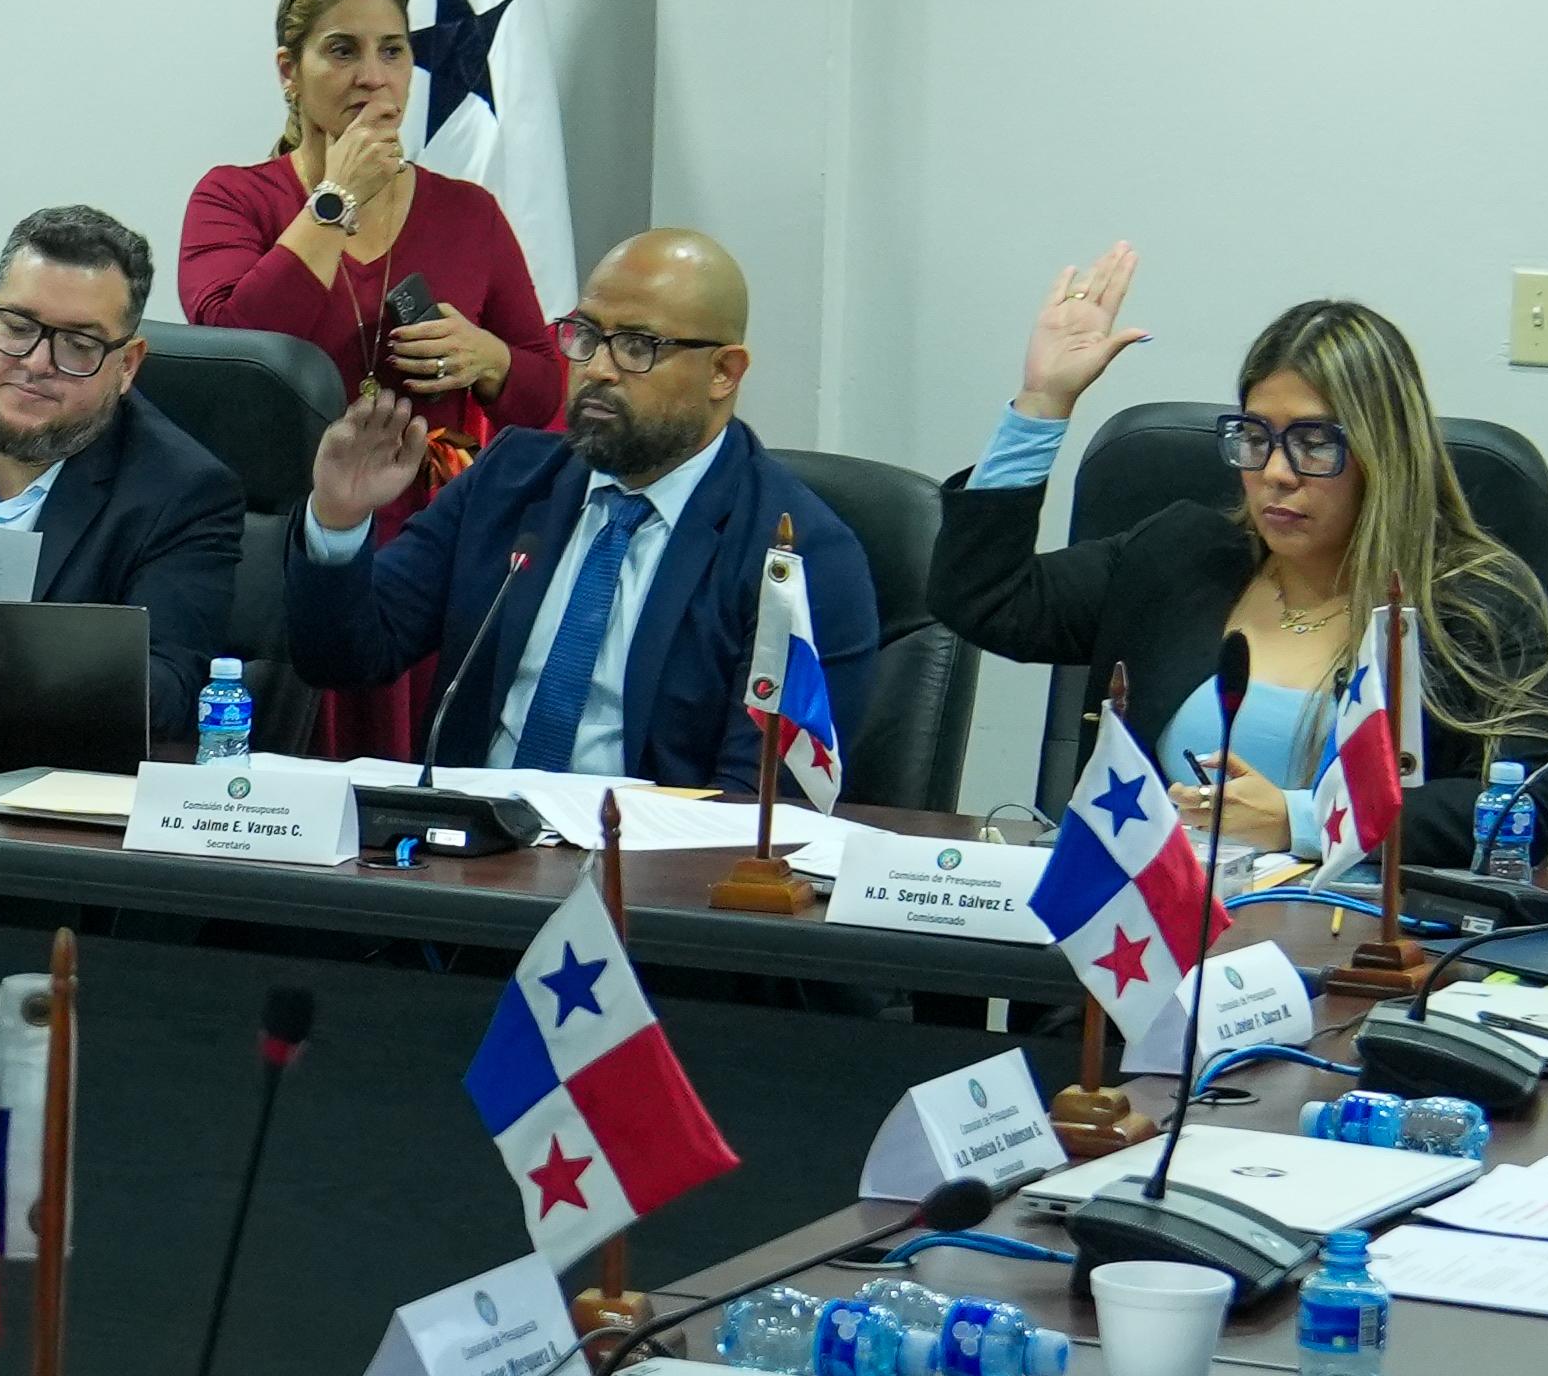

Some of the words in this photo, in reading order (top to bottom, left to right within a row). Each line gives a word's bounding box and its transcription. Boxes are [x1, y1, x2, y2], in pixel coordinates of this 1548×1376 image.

[183, 800, 222, 811] Comisión
[224, 803, 234, 812] de
[236, 803, 290, 816] Presupuesto
[161, 816, 184, 830] H.D.
[192, 818, 229, 832] Jaime
[233, 820, 242, 833] E.
[248, 822, 287, 837] Vargas
[291, 824, 302, 837] C.
[206, 839, 251, 850] Secretario
[889, 870, 931, 883] Comisión
[932, 874, 943, 884] de
[945, 874, 1002, 888] Presupuesto
[865, 886, 889, 900] H.D.
[897, 889, 937, 905] Sergio
[942, 893, 954, 906] R.
[958, 894, 1000, 911] Gálvez
[1004, 899, 1015, 912] E.
[907, 912, 966, 926] Comisionado
